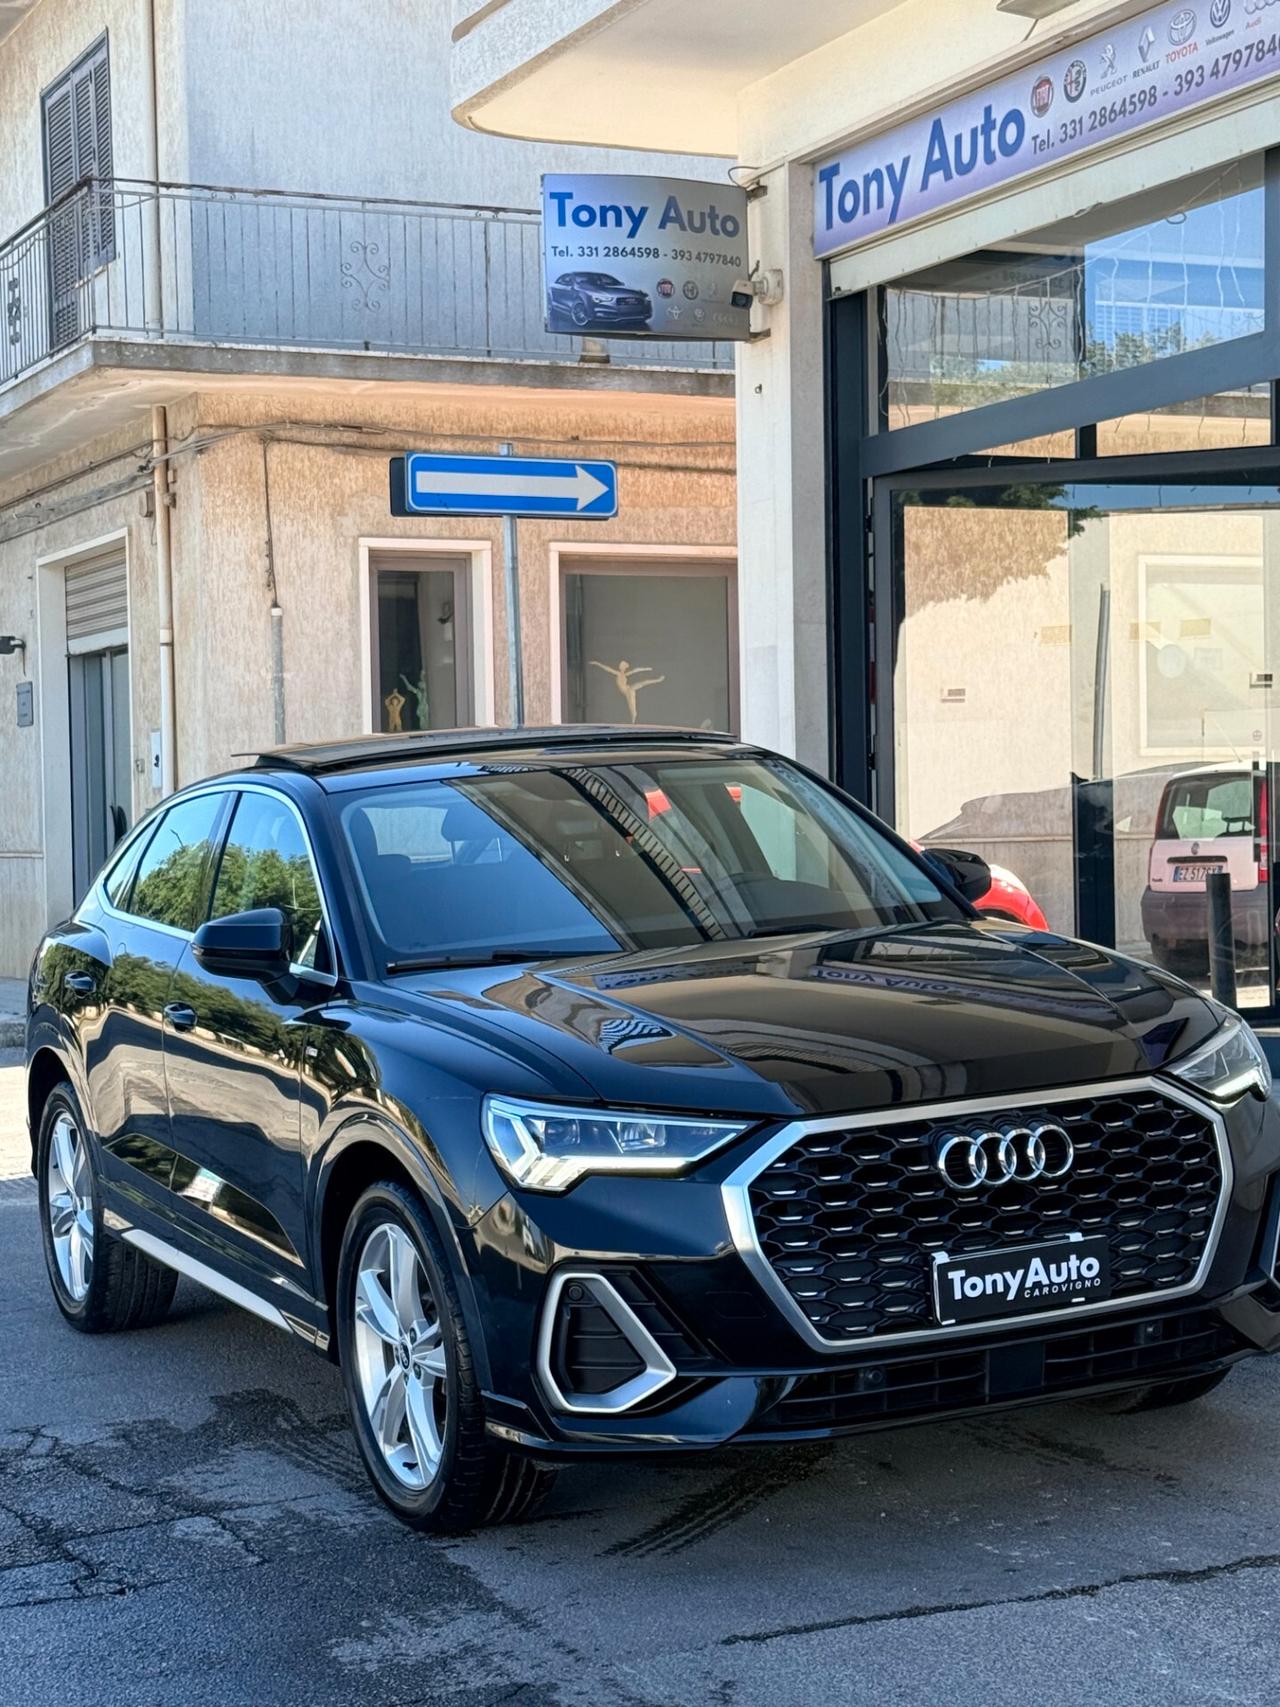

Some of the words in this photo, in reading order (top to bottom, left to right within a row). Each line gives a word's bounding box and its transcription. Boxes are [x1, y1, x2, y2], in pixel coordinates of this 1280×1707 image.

[1165, 41, 1199, 64] TOYOTA
[1132, 60, 1161, 79] RENAULT
[1031, 129, 1055, 155] Tel.
[1059, 117, 1083, 145] 331
[1088, 84, 1157, 132] 2864598
[1174, 64, 1205, 97] 393
[1209, 33, 1280, 79] 479784
[1090, 74, 1128, 97] PEUGEOT
[819, 156, 910, 231] Tony
[920, 104, 1025, 193] Auto
[549, 192, 649, 239] Tony
[658, 195, 740, 238] Auto
[551, 246, 574, 258] Tel.
[577, 246, 599, 258] 331
[603, 246, 660, 259] 2864598
[671, 249, 692, 261] 393
[695, 251, 741, 267] 4797840
[1024, 1278, 1101, 1298] CAROVIGNO
